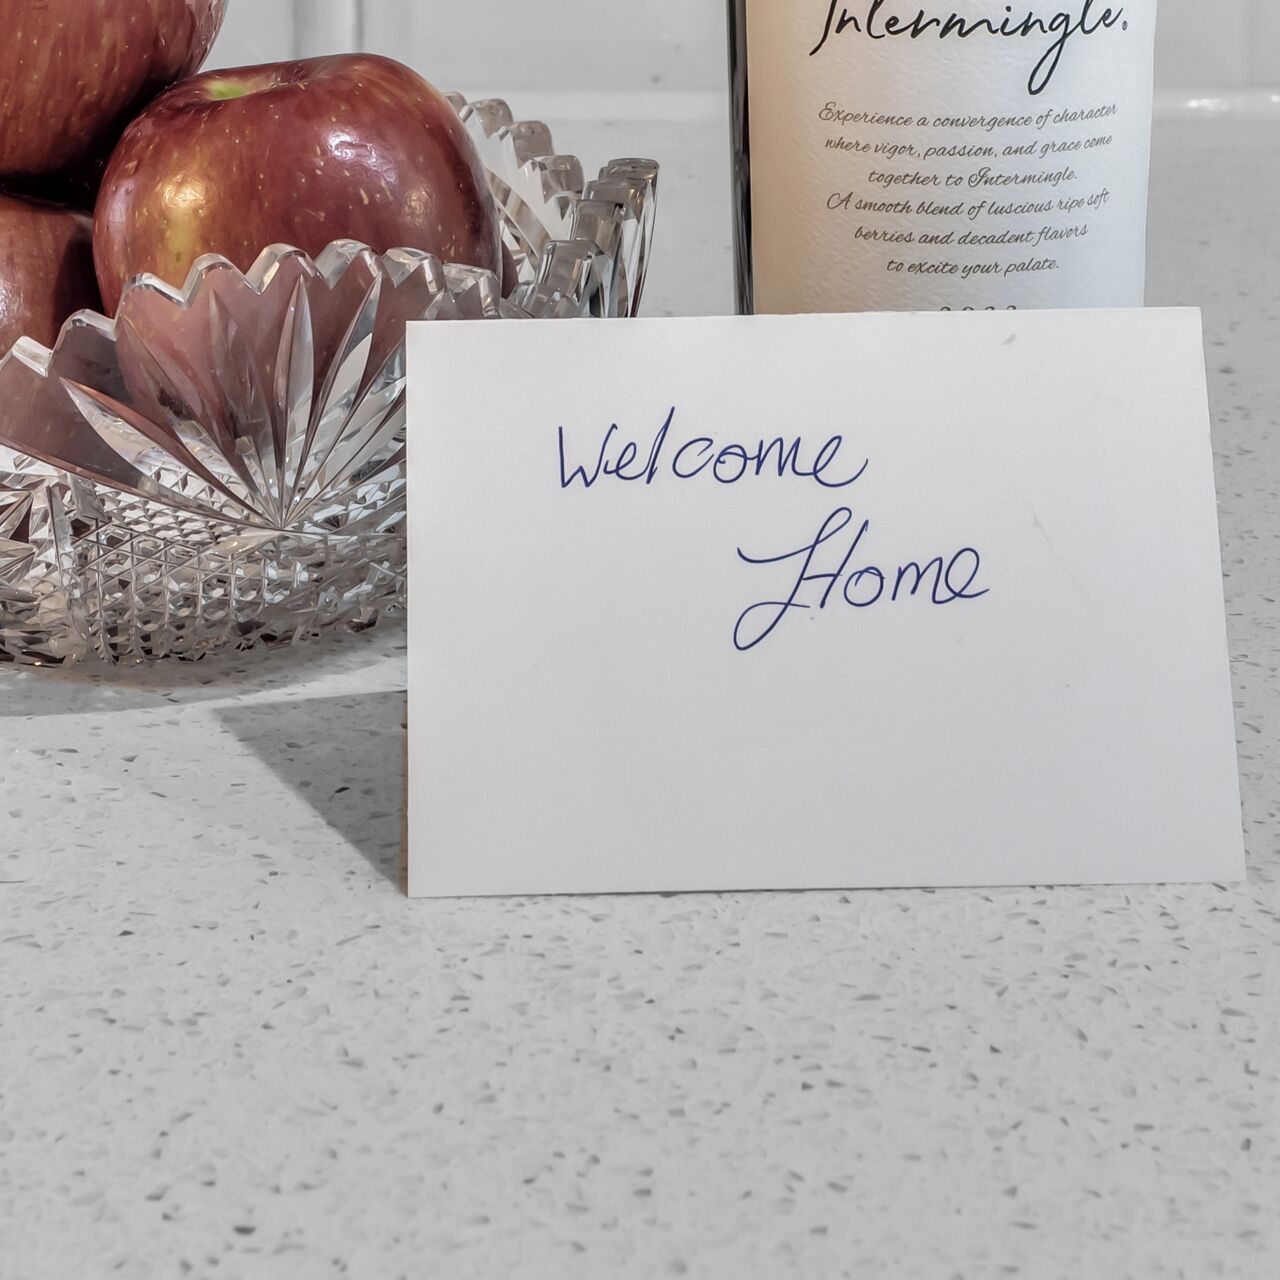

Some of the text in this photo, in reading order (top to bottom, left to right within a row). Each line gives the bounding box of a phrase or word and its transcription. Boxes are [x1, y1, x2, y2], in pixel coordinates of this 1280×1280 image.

[818, 101, 1118, 132] Experience a convergence of character
[825, 134, 1113, 161] where vigor, passion, and grace come
[868, 166, 1078, 189] together to Intermingle.
[826, 187, 1111, 221] A smooth blend of luscious ripe soft
[854, 223, 1089, 248] berries and decadent flavors
[886, 256, 1060, 280] to excite your palate.
[556, 406, 869, 489] Welcome
[733, 506, 990, 651] Home
